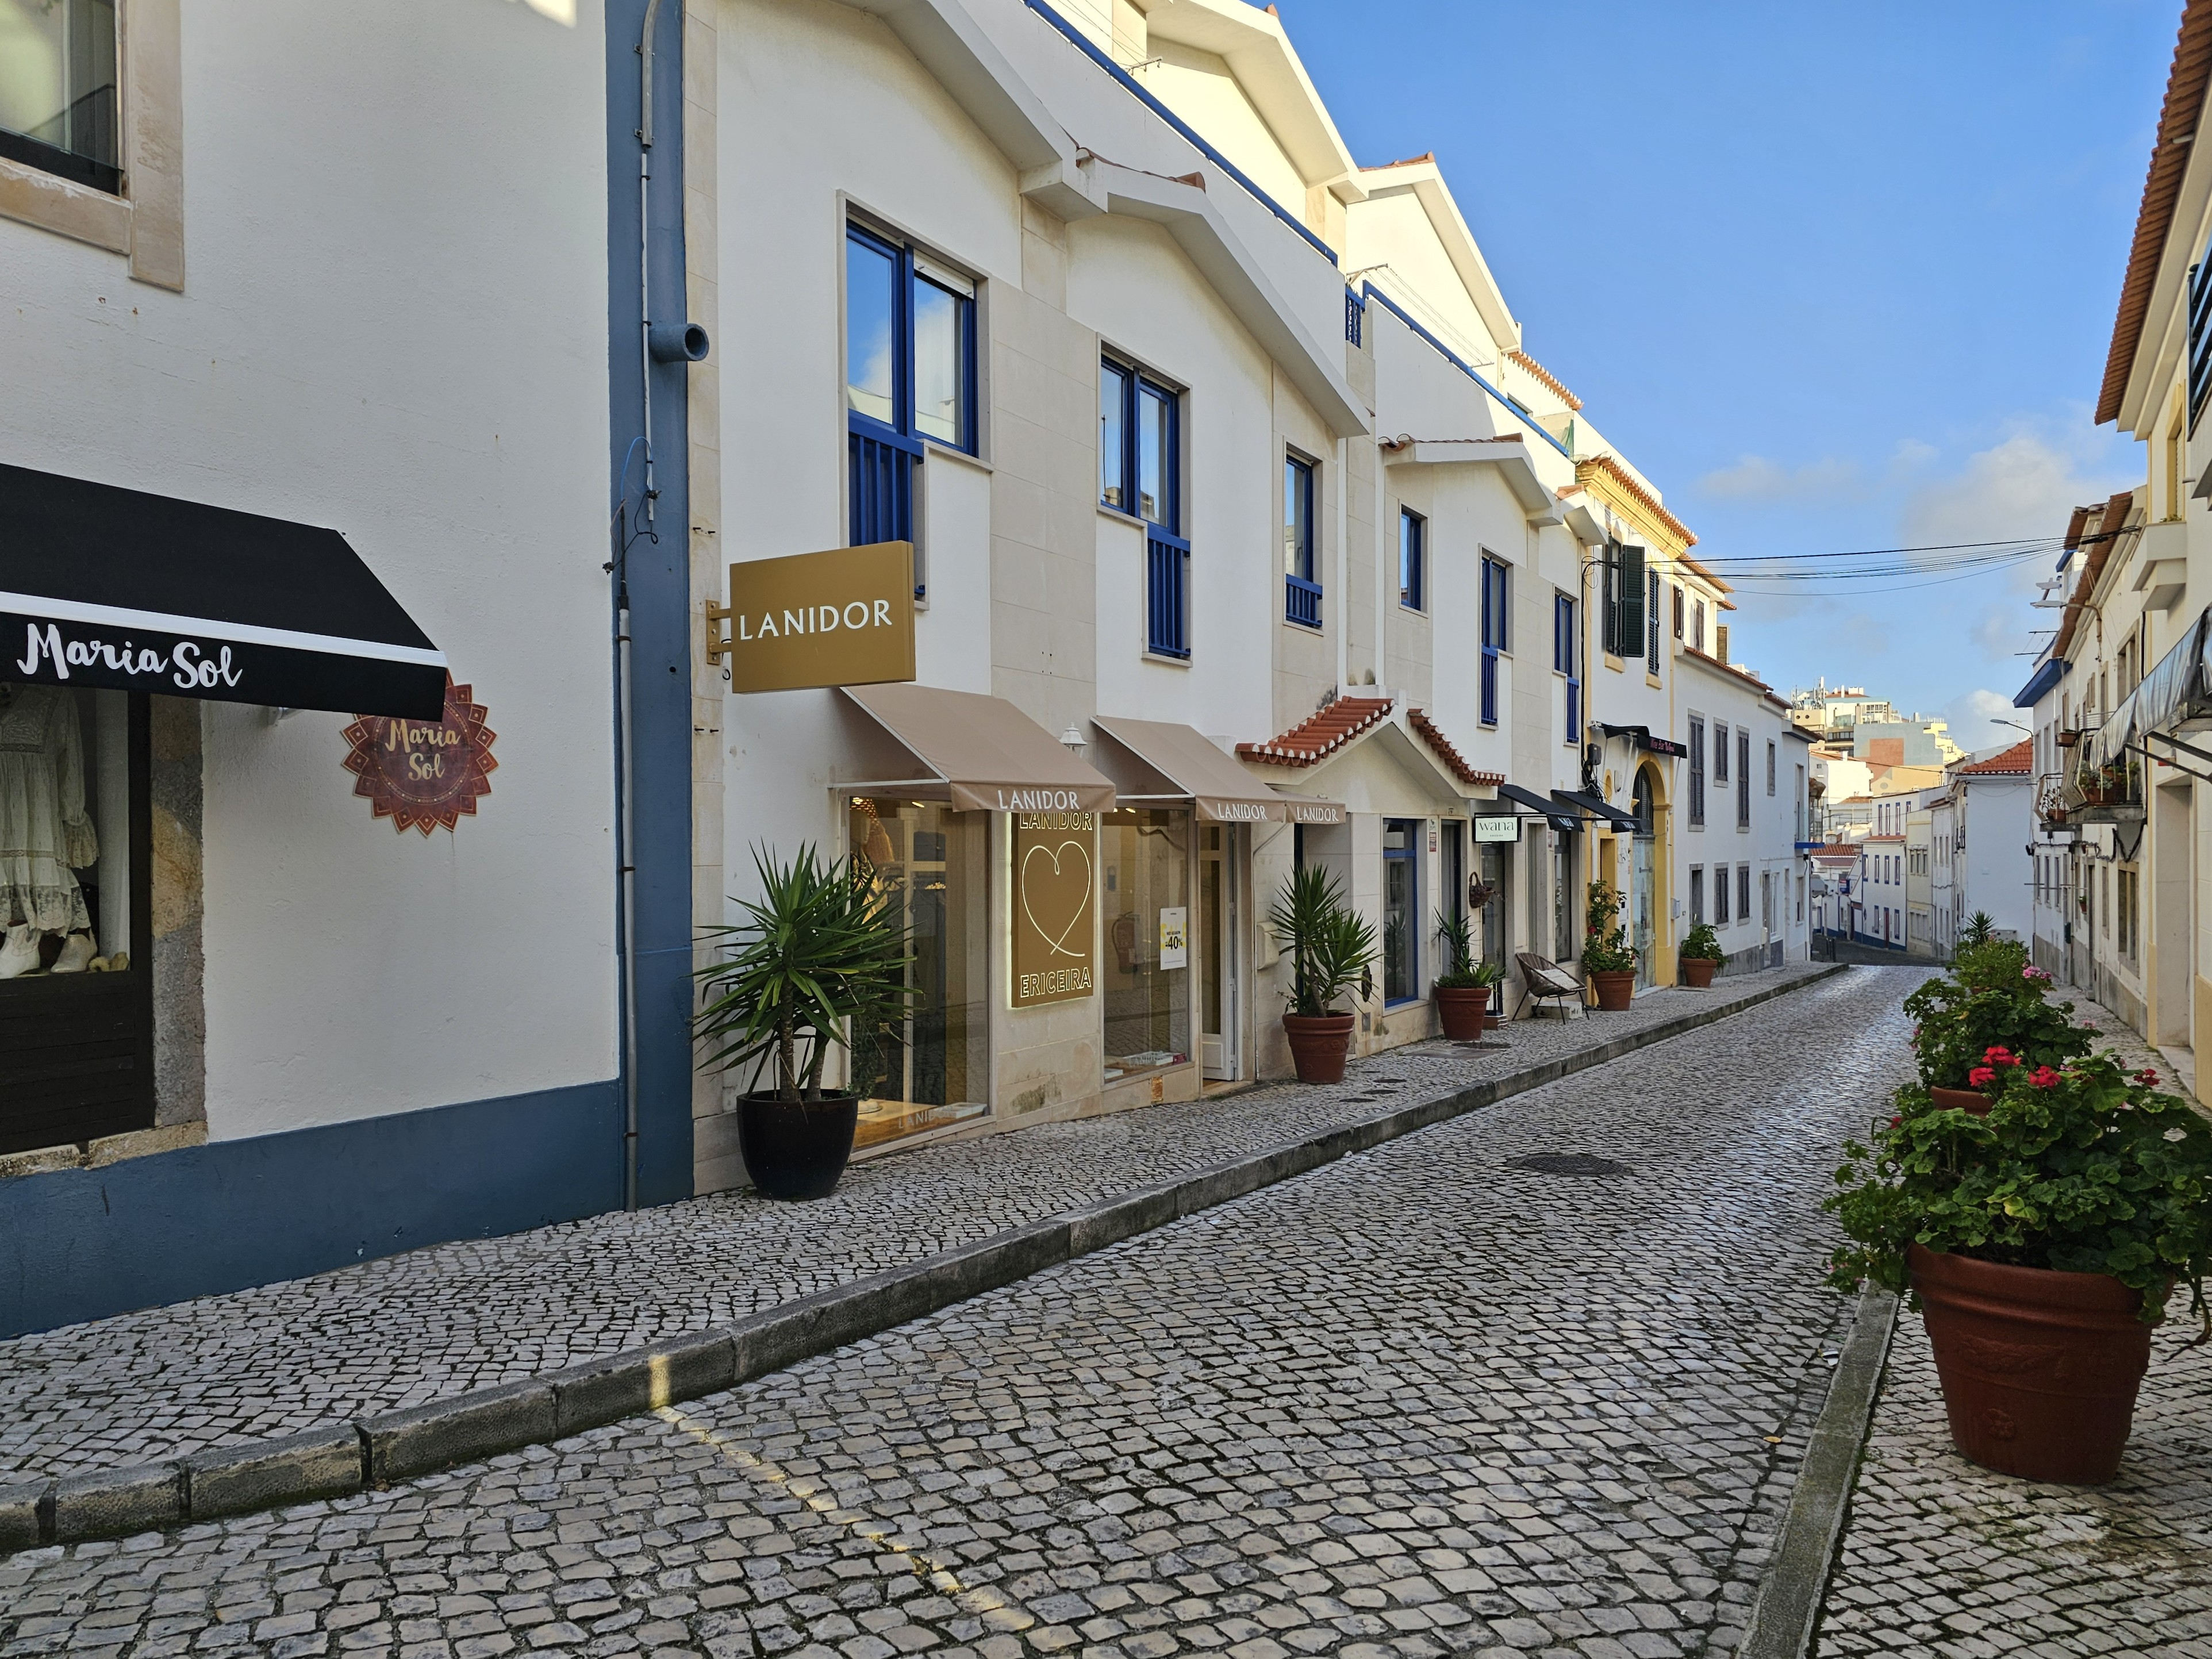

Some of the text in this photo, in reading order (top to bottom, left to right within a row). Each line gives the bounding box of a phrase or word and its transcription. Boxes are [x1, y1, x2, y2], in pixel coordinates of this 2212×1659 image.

[739, 600, 893, 640] LANIDOR
[17, 624, 243, 688] Maria Sol
[385, 719, 460, 753] Maria
[408, 752, 446, 781] Sol
[998, 789, 1080, 810] LANIDOR
[1218, 803, 1268, 820] LANIDOR
[1020, 812, 1093, 831] LANIDOR
[1297, 807, 1339, 822] LANIDOR
[1479, 821, 1514, 831] wana
[1020, 967, 1092, 998] ERICEIRA
